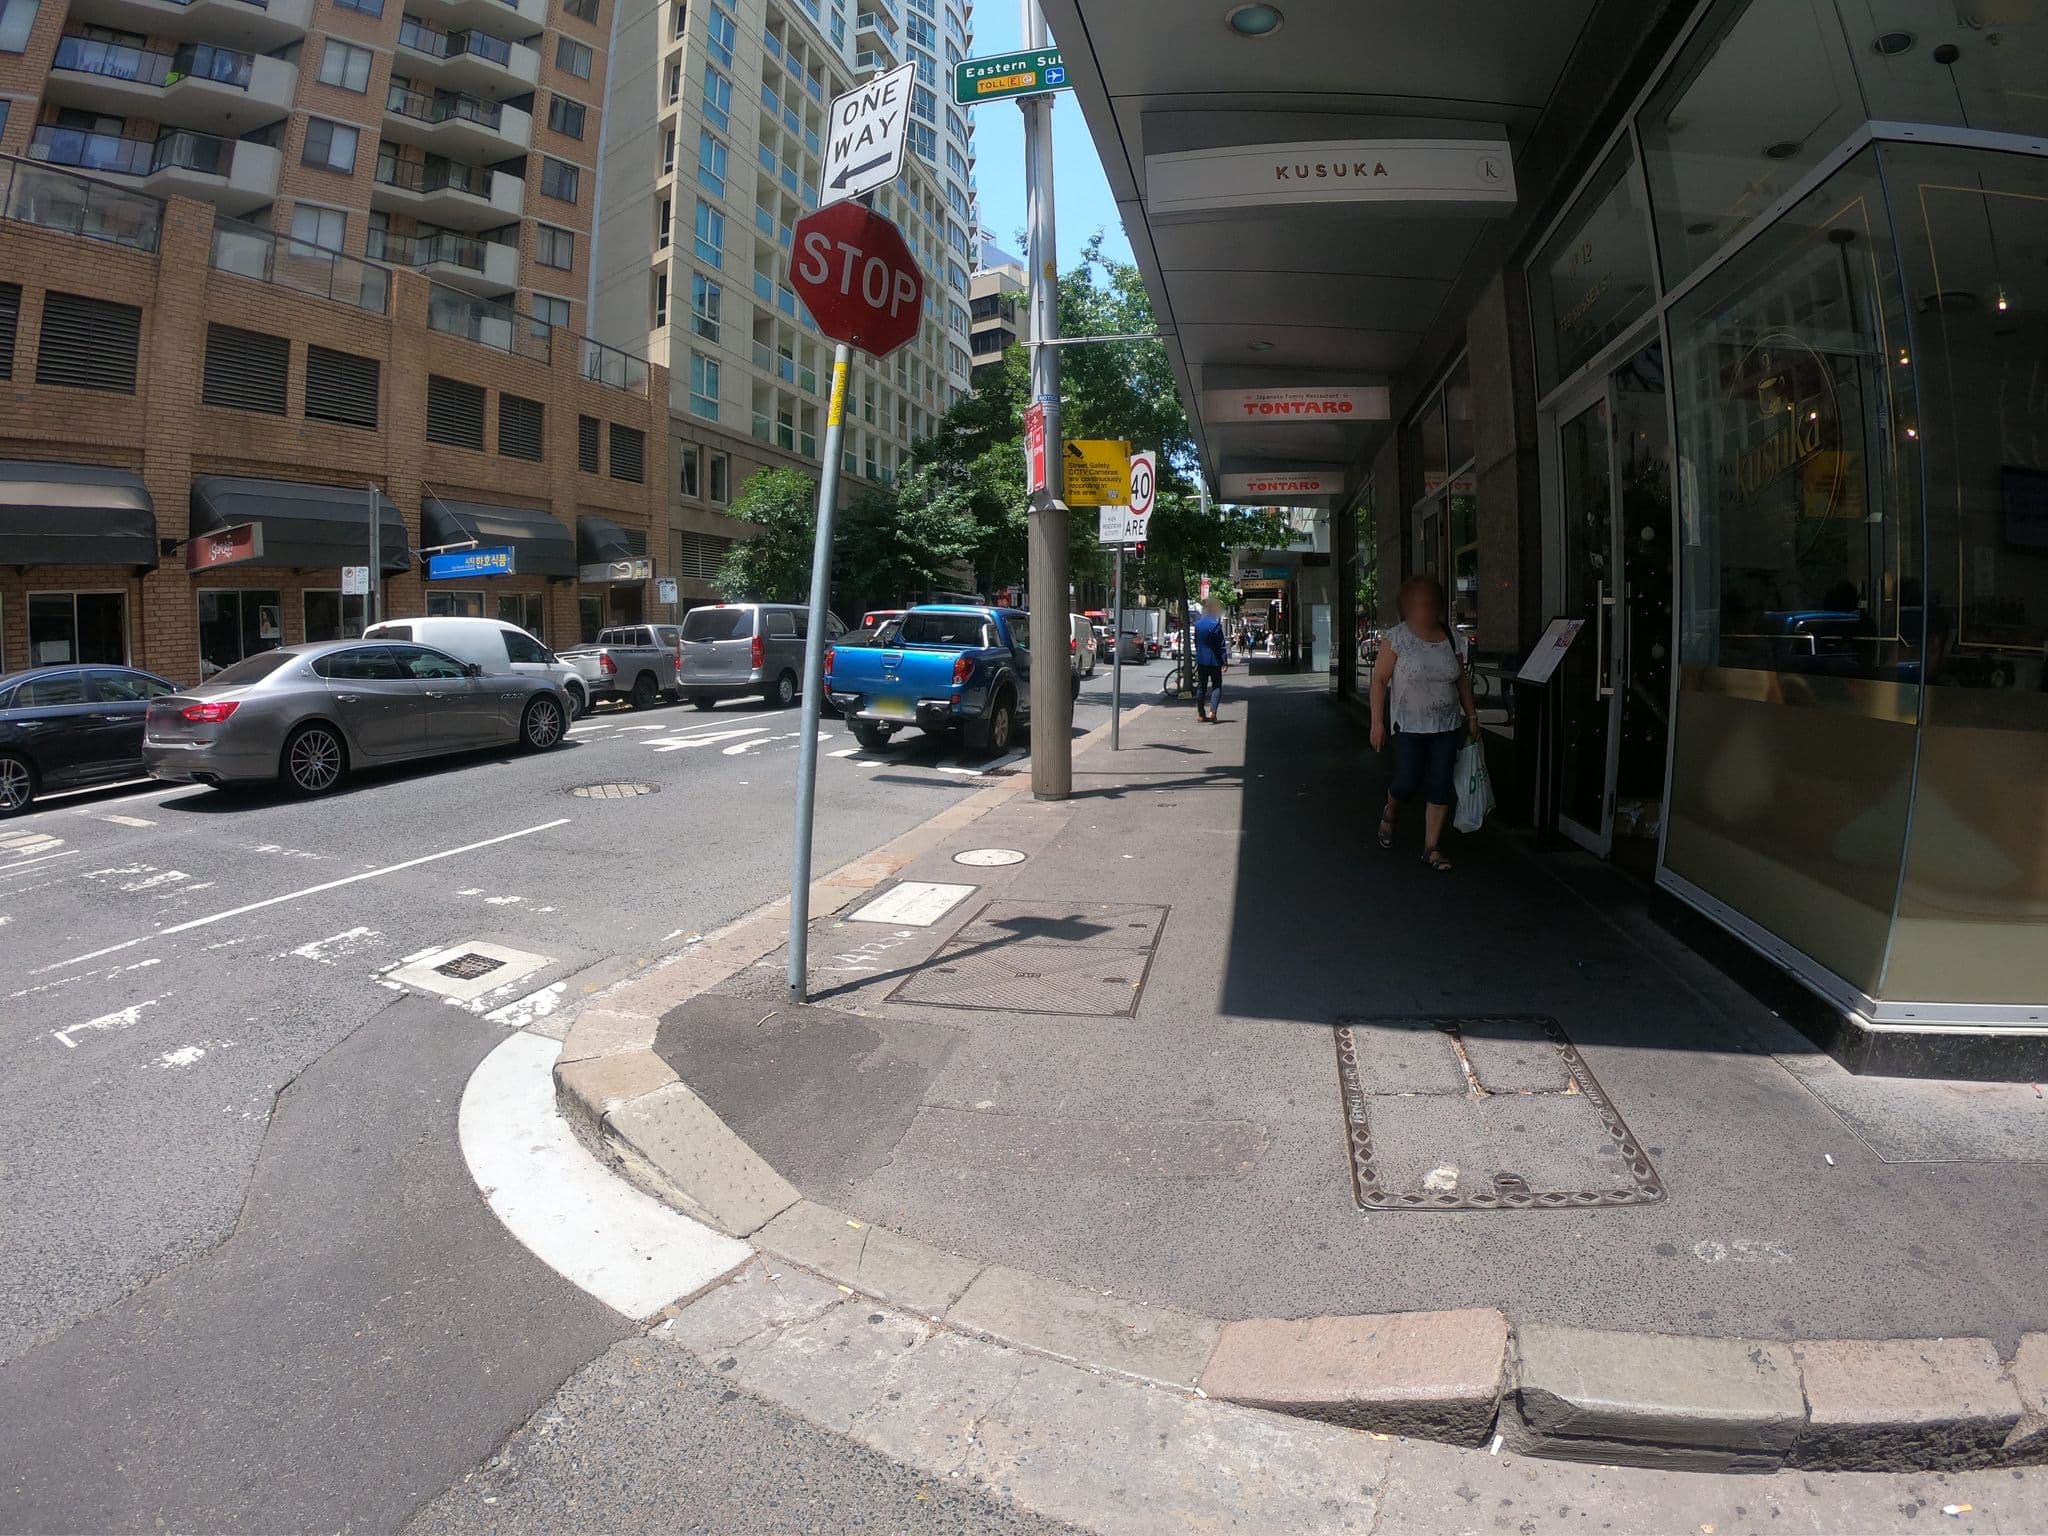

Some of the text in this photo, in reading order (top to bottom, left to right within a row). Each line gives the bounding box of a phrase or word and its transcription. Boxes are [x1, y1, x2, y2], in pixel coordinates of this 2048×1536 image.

[966, 61, 1027, 78] Eastern
[979, 79, 1006, 90] TOLL
[842, 77, 900, 127] ONE
[833, 110, 898, 164] WAY
[1275, 161, 1389, 180] KUSUKA
[799, 231, 917, 318] STOP
[1243, 401, 1353, 415] TONTARO
[1090, 462, 1110, 470] Safety
[1131, 472, 1150, 500] 40
[1247, 481, 1320, 491] TONTARO
[1124, 519, 1147, 537] ARE
